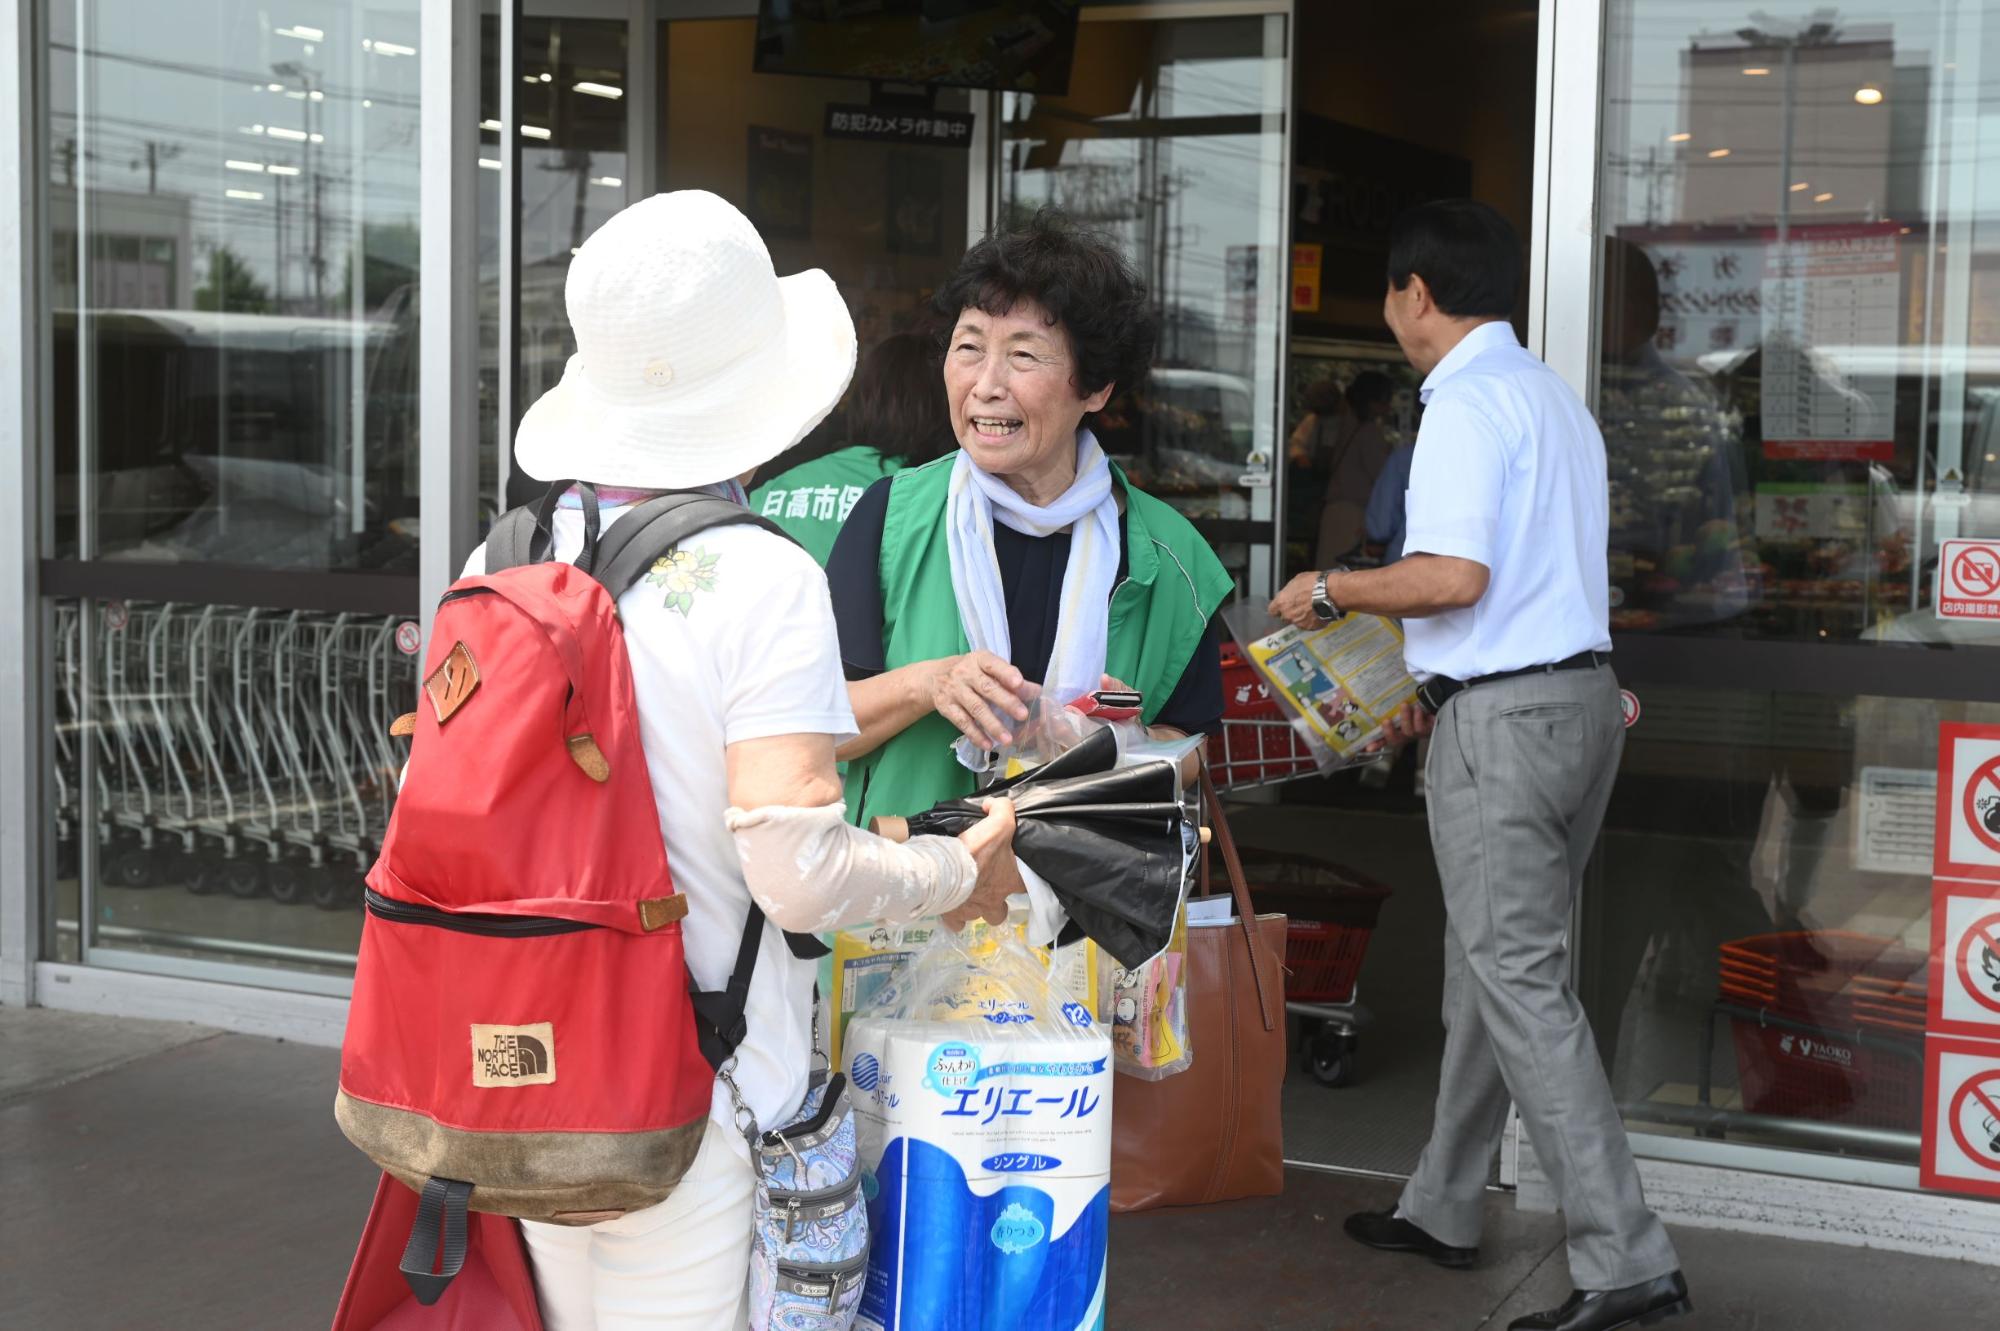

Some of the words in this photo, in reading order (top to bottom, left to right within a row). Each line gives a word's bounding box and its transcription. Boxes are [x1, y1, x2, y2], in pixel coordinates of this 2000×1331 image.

[831, 112, 967, 139] 防犯カメラ作動中
[1943, 602, 2000, 615] 店内撮影禁
[494, 1035, 516, 1049] THE
[478, 1048, 517, 1063] NORTH
[1812, 1042, 1852, 1060] YAOKO
[485, 1063, 519, 1078] FACE
[933, 1058, 976, 1073] ふんわり
[941, 1086, 1100, 1125] エリエール
[993, 1156, 1047, 1170] シングル
